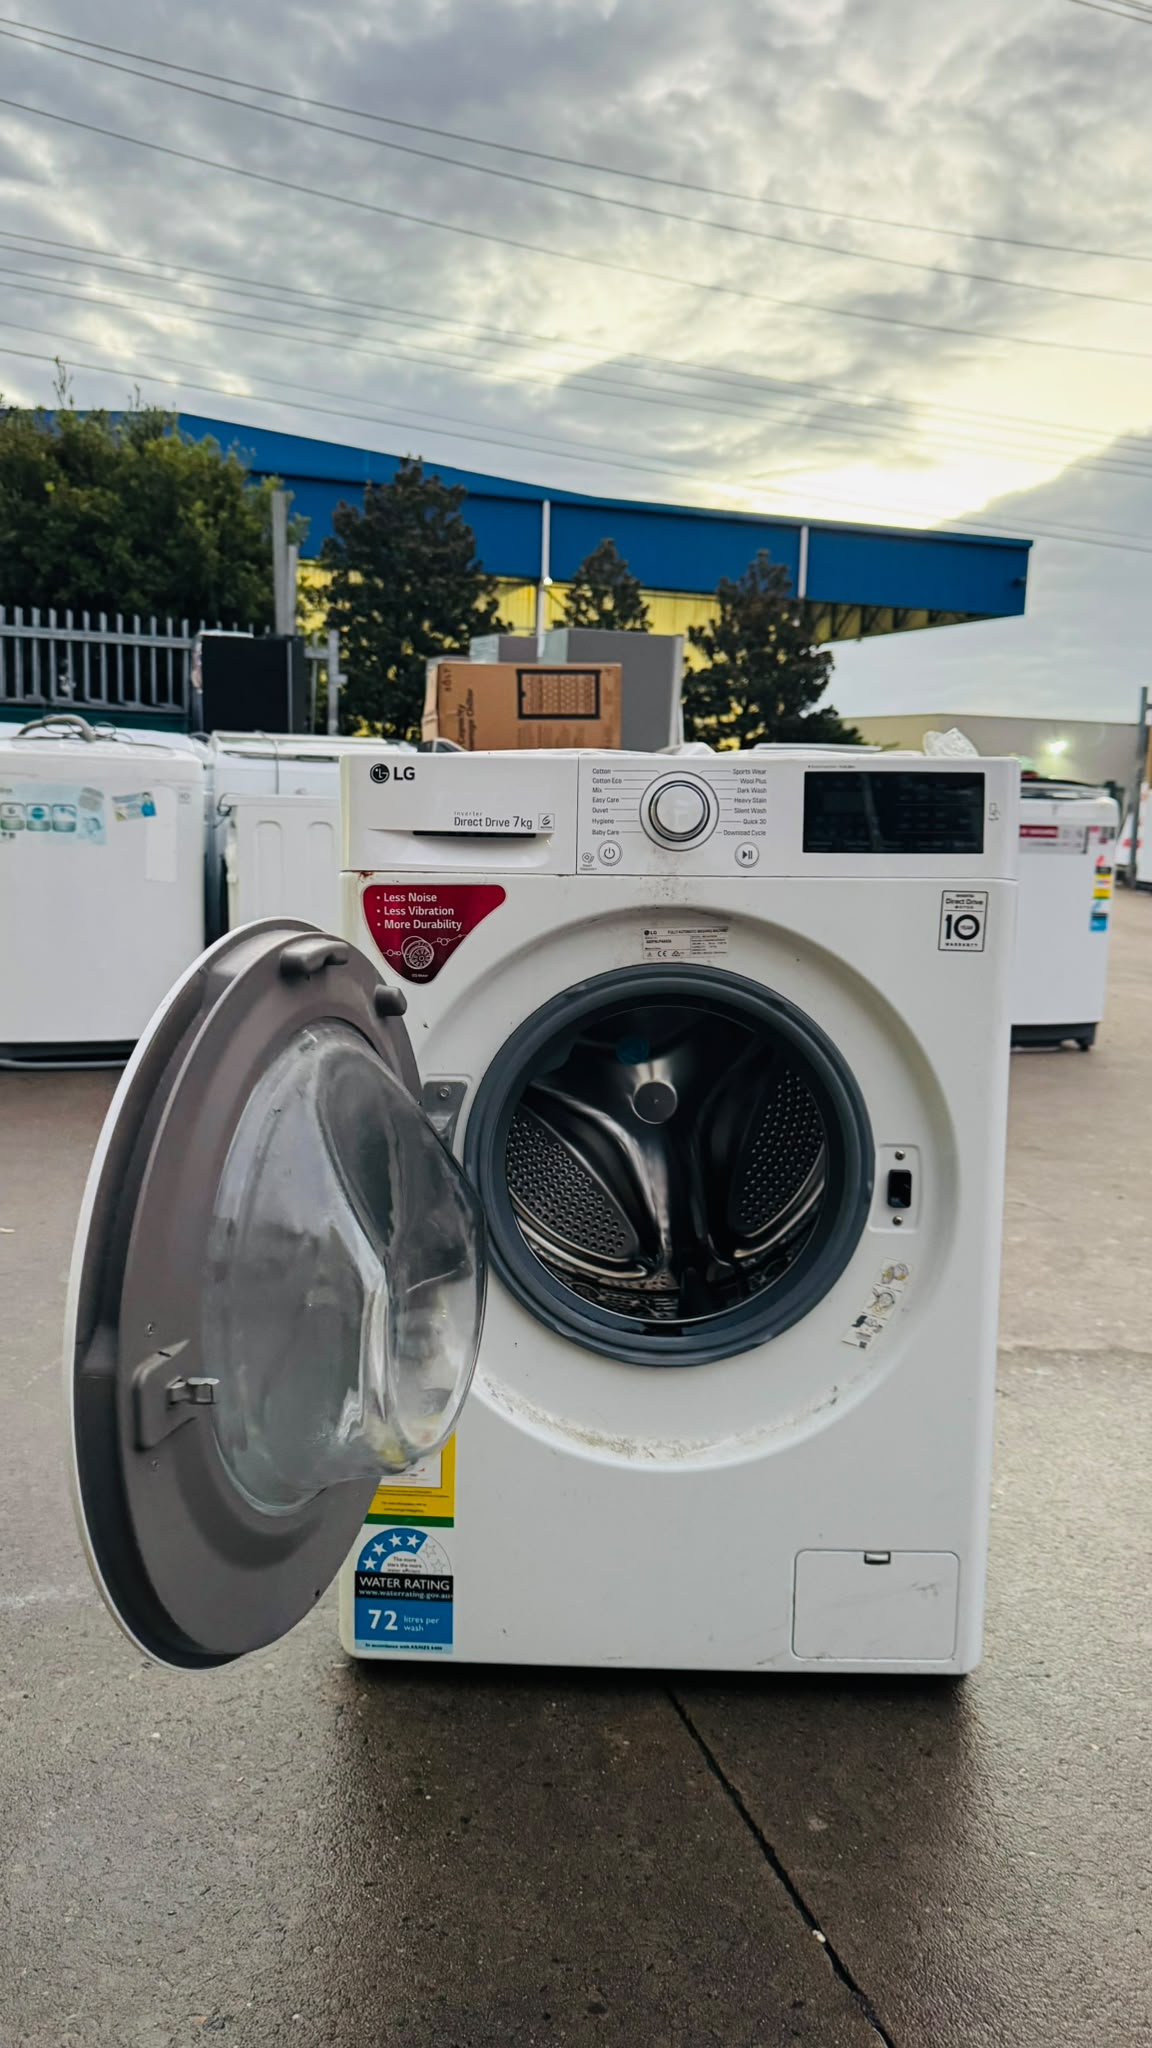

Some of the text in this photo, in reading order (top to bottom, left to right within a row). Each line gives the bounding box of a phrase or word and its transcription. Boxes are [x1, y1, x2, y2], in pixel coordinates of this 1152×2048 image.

[393, 766, 415, 781] LG
[592, 796, 606, 804] Easy
[454, 815, 533, 830] Direct Drive 7kg
[592, 829, 606, 837] Baby
[384, 892, 437, 902] Less Noise
[384, 906, 455, 916] Less Vibration
[384, 919, 462, 931] More Durability
[945, 914, 981, 940] 10
[360, 1576, 450, 1591] WATER RATING
[368, 1609, 398, 1631] 72
[403, 1616, 440, 1626] litres per
